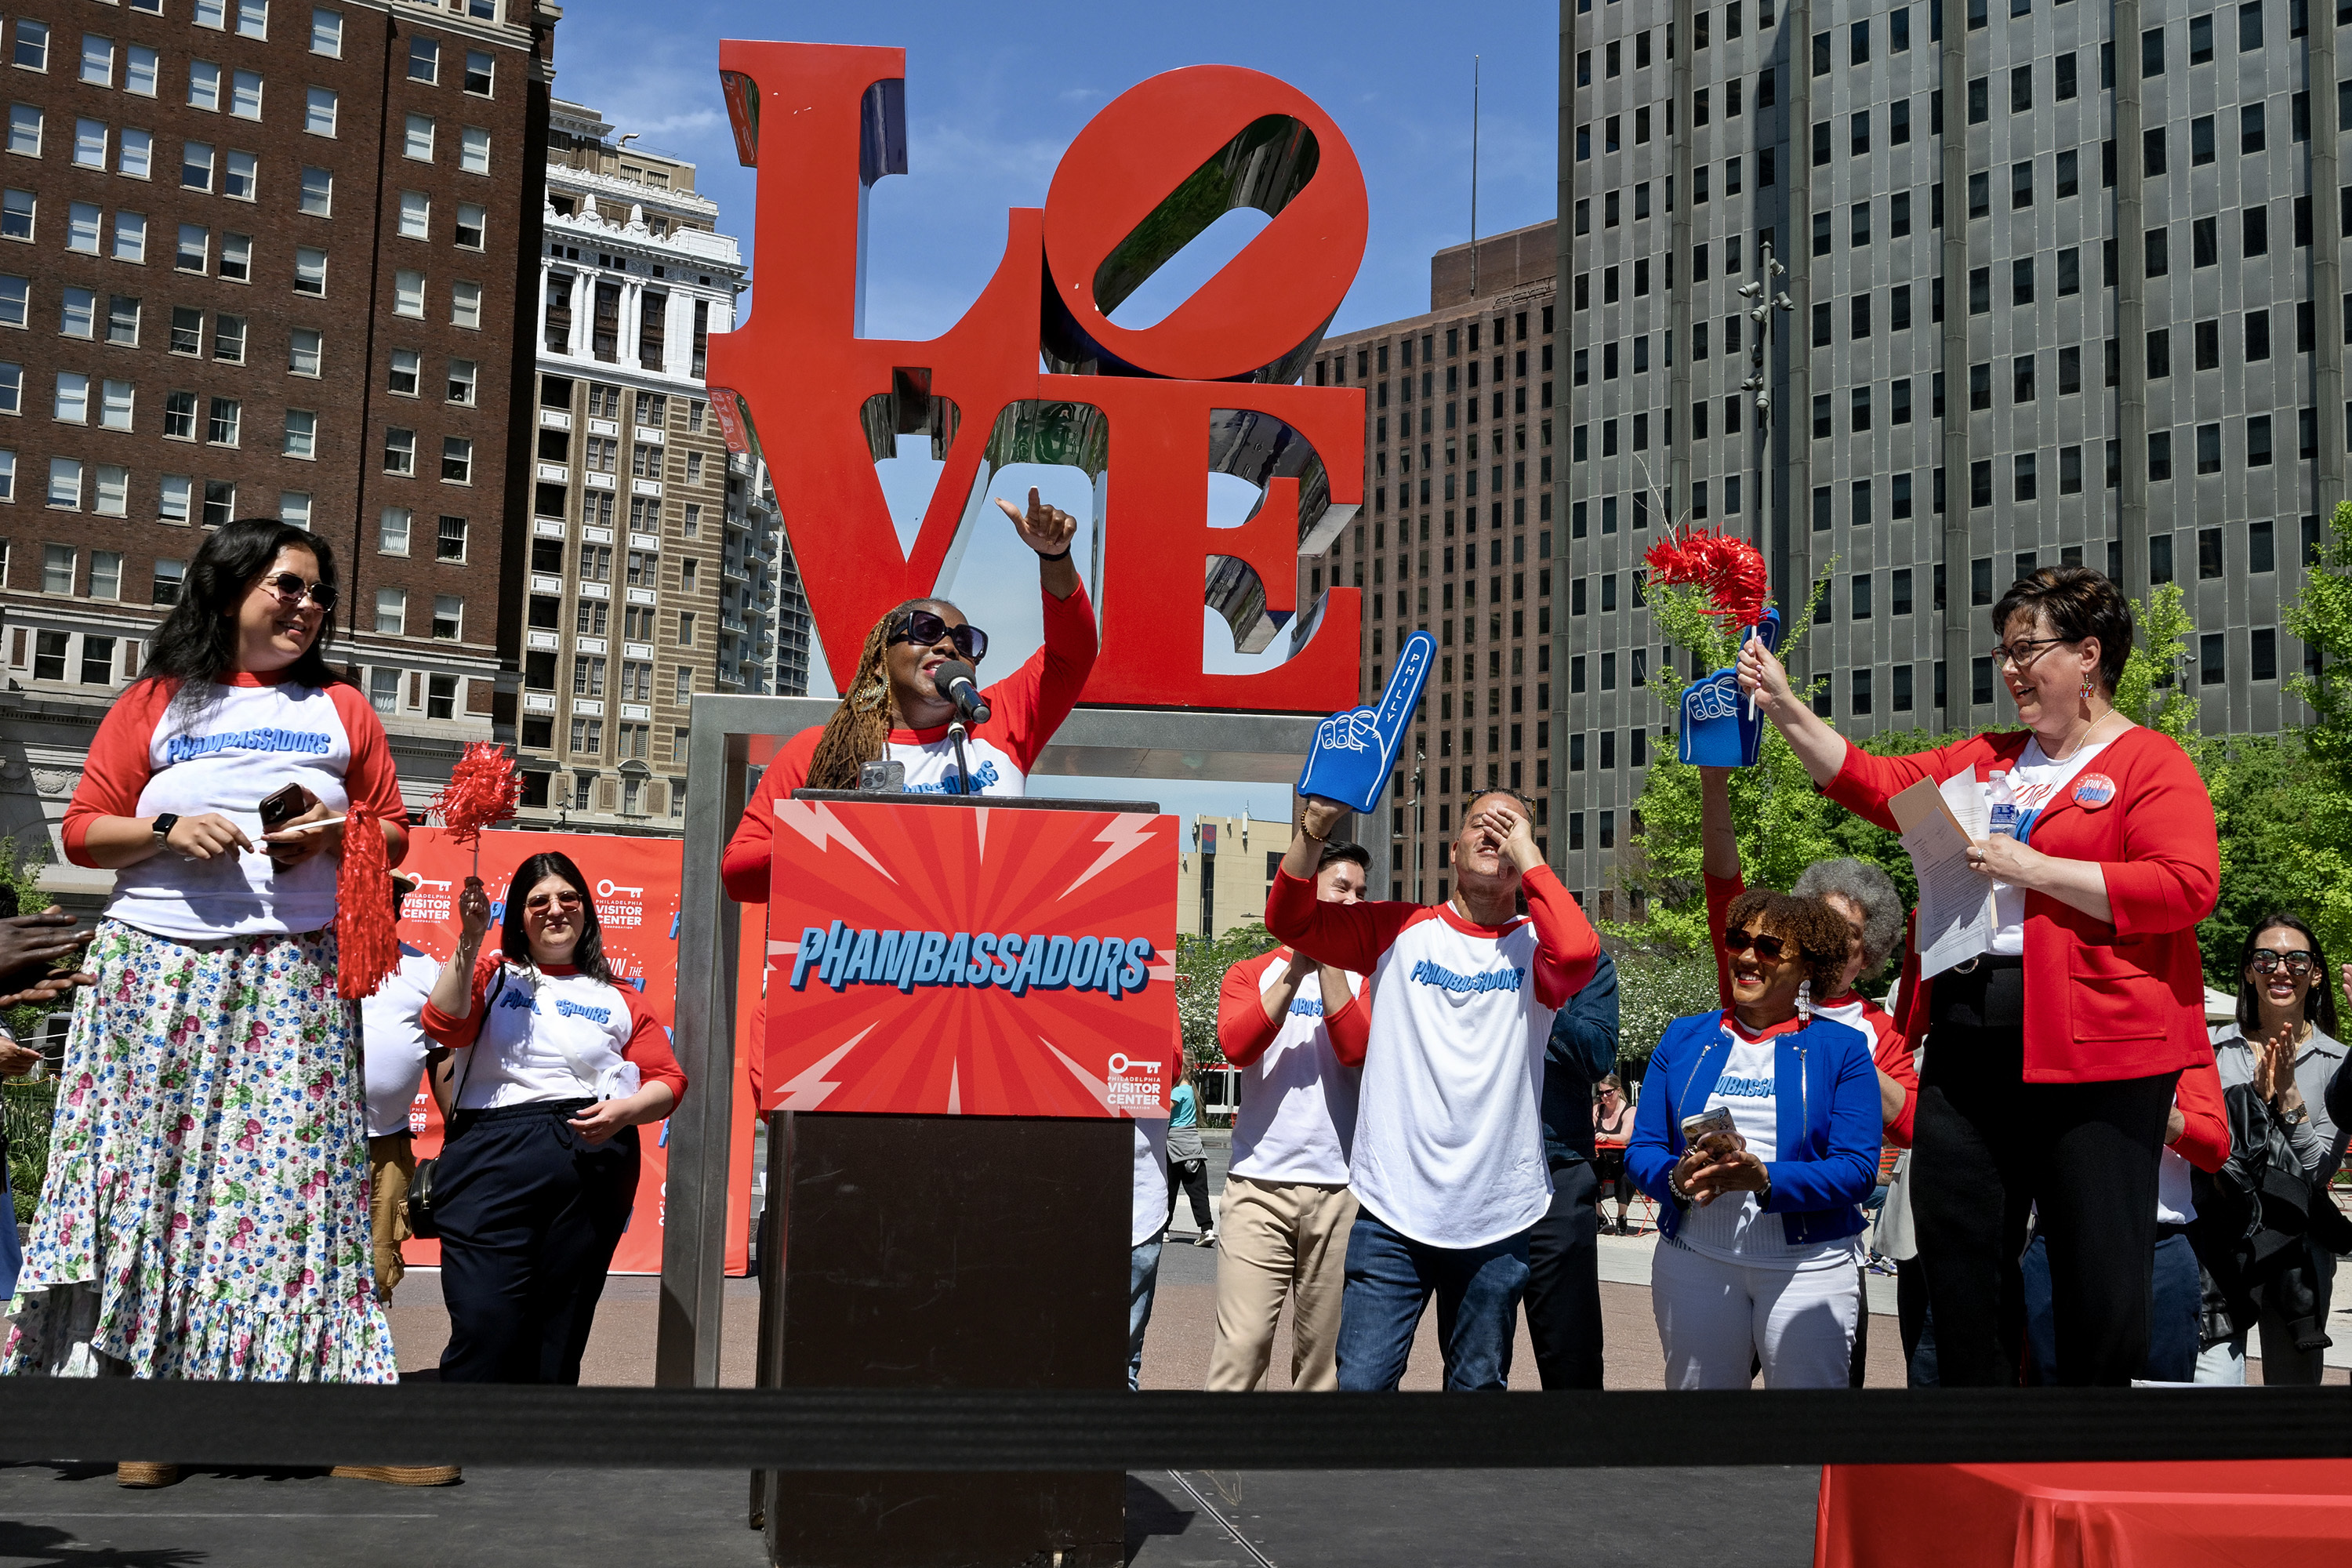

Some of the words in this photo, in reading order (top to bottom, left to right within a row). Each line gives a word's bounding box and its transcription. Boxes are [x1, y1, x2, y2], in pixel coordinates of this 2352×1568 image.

[1387, 653, 1420, 723] PHILLY
[166, 727, 332, 764] PHAMBASSADORS
[2082, 779, 2103, 789] JOIN
[2074, 786, 2111, 804] PHAM
[28, 834, 64, 844] INSUR
[403, 898, 451, 909] VISITOR
[402, 909, 450, 920] CENTER
[596, 905, 643, 916] VISITOR
[597, 915, 642, 926] CENTER
[789, 920, 1154, 1001] PHAMBASSADORS
[629, 967, 644, 977] THE
[1107, 1082, 1161, 1094] VISITOR
[1107, 1094, 1160, 1105] CENTER
